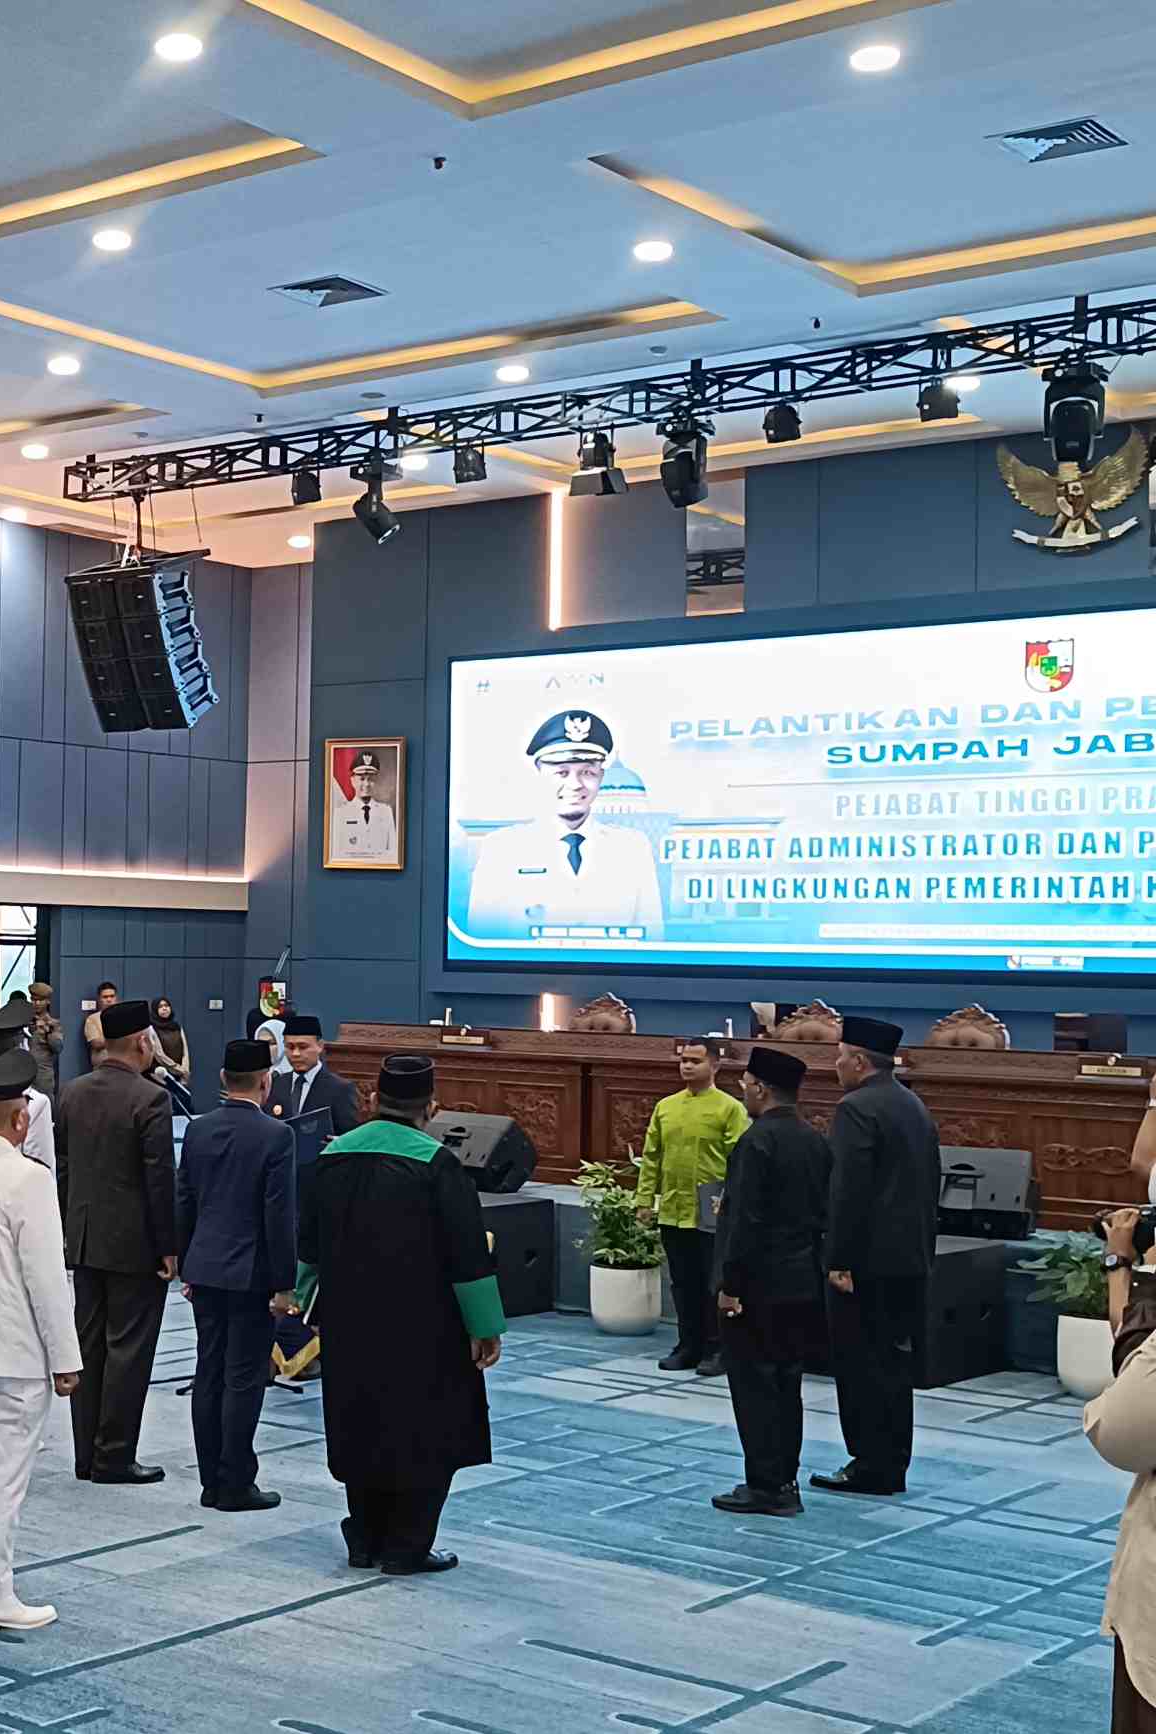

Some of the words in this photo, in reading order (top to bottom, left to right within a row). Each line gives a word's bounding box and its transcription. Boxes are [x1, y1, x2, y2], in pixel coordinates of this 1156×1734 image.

[670, 707, 958, 739] PELANTIKAN
[981, 699, 1082, 724] DAN
[827, 739, 1029, 765] SUMPAH
[1052, 733, 1155, 756] JAB
[836, 792, 960, 817] PEJABAT
[975, 788, 1086, 814] TINGGI
[664, 837, 776, 860] PEJABAT
[789, 833, 1042, 859] ADMINISTRATOR
[1058, 831, 1122, 855] DAN
[688, 878, 713, 899] DI
[727, 877, 911, 899] LINGKUNGAN
[926, 876, 1130, 899] PEMERINTAH
